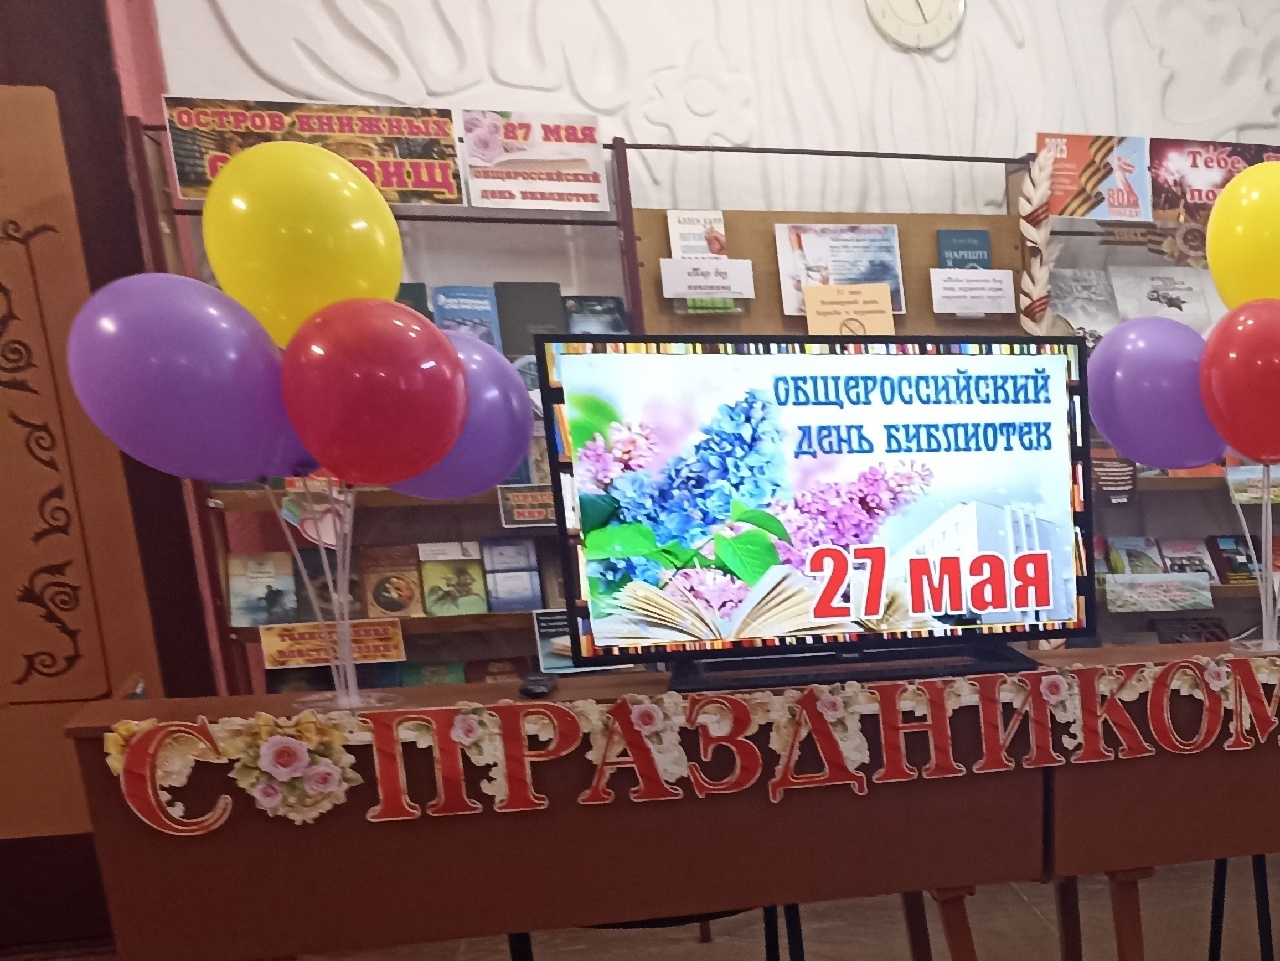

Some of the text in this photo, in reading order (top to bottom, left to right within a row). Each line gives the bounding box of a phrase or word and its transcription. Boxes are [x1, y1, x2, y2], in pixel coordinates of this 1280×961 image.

[176, 109, 452, 137] ОСТРОВ КНИЖНЫХ
[206, 153, 456, 195] СВИЩ
[773, 369, 1052, 409] ОБЩЕРОССИЙСКИЙ
[794, 421, 1053, 459] ДЕНЬ БИБЛИОТЕК
[807, 546, 1052, 620] 27 мая
[120, 715, 233, 836] С
